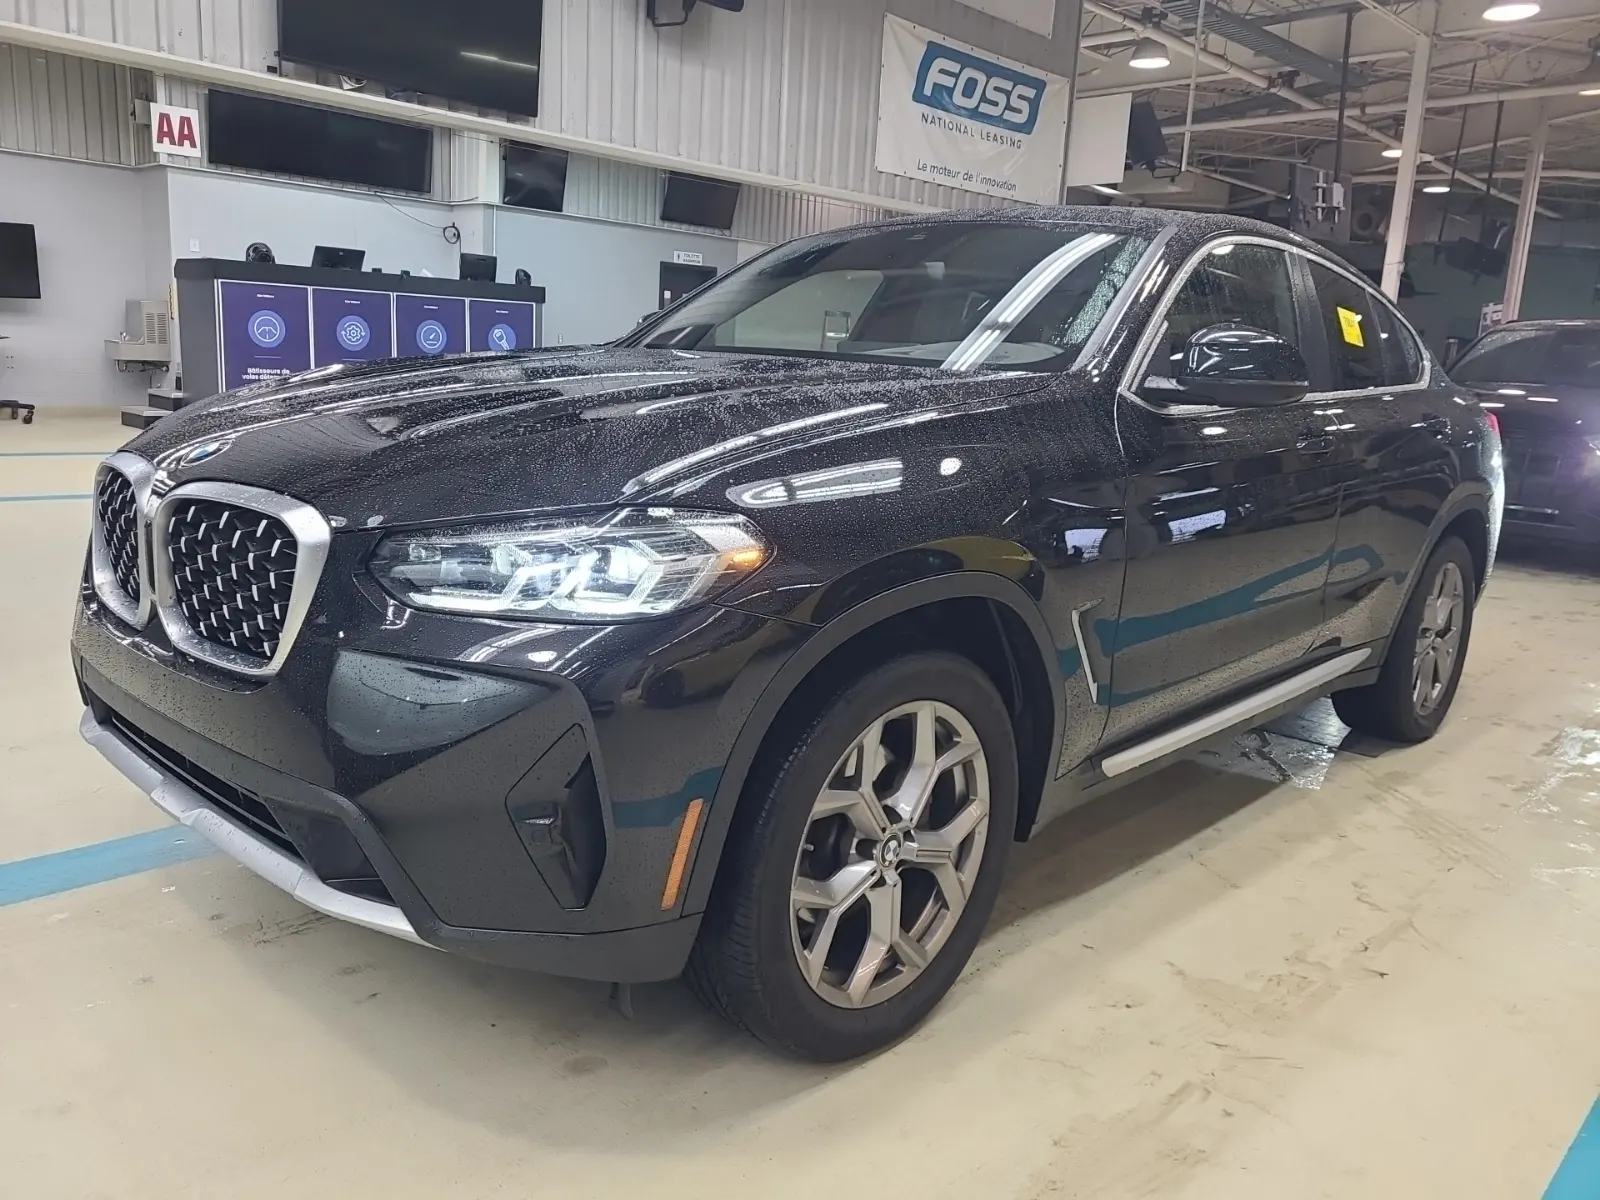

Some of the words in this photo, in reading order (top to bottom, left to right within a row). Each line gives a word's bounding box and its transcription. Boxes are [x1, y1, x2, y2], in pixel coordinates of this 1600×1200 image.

[923, 57, 1037, 124] FOSS
[157, 112, 197, 149] AA
[921, 112, 975, 138] NATIONAL
[980, 129, 1022, 149] LEASING
[917, 158, 928, 172] Le
[929, 163, 961, 179] moteur
[962, 169, 974, 182] de
[976, 172, 1017, 192] l'innovation
[281, 367, 291, 375] de
